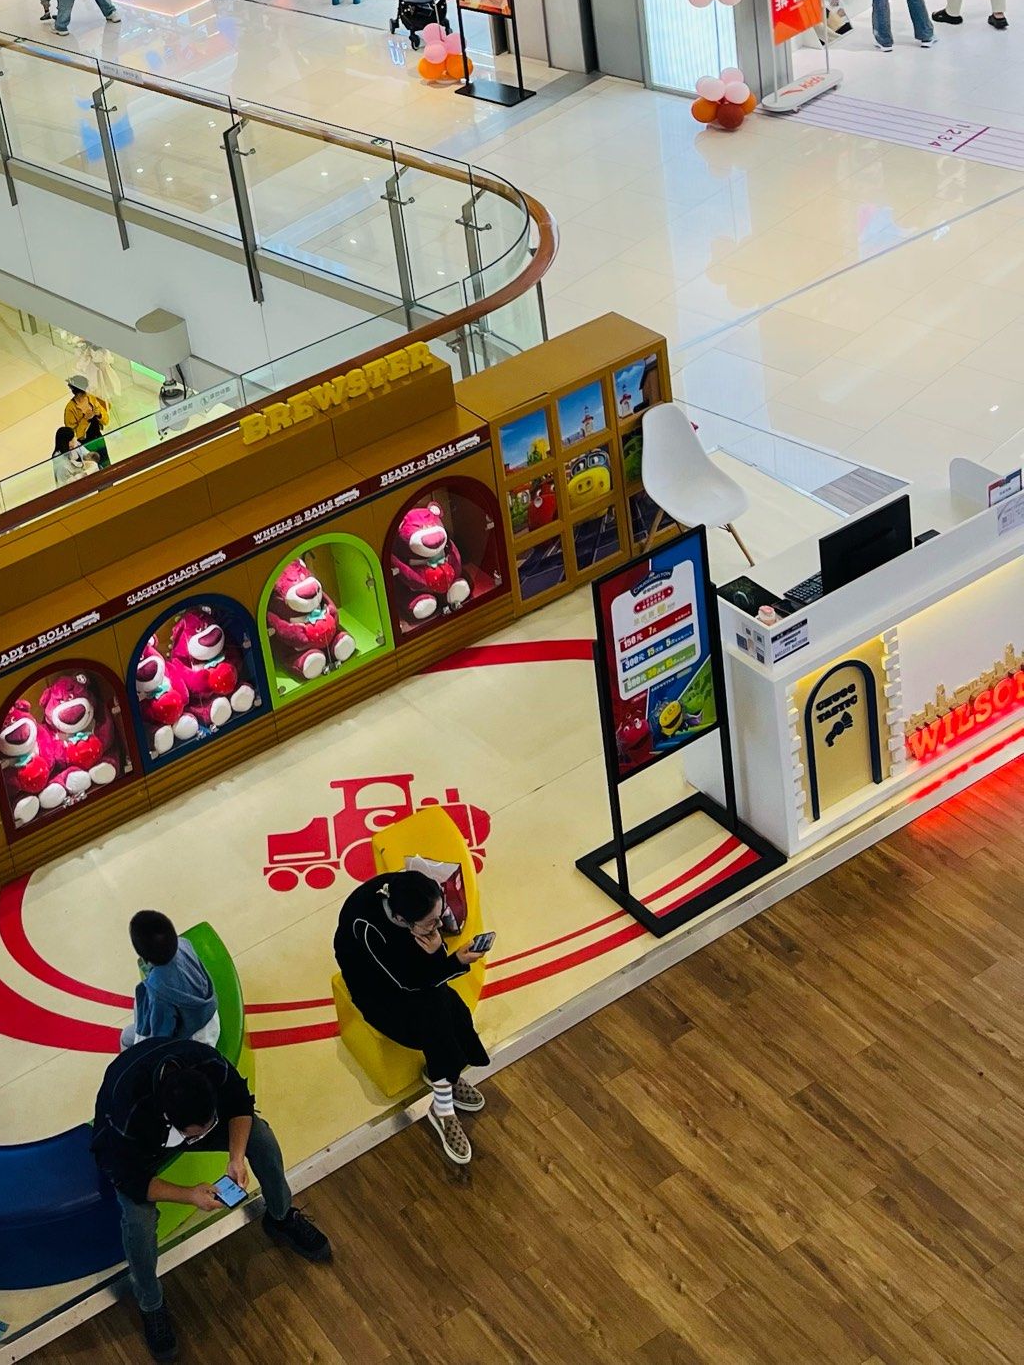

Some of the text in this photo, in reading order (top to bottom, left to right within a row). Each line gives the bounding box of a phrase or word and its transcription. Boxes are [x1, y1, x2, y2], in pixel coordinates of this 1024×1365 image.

[239, 341, 433, 445] BREWSTER
[380, 461, 416, 484] READY
[426, 443, 456, 463] ROLL
[253, 516, 294, 543] WHEELS
[303, 499, 334, 520] RAILS
[126, 562, 200, 603] CLACKETY CLACK
[26, 641, 38, 653] TO
[37, 623, 72, 646] ROLL
